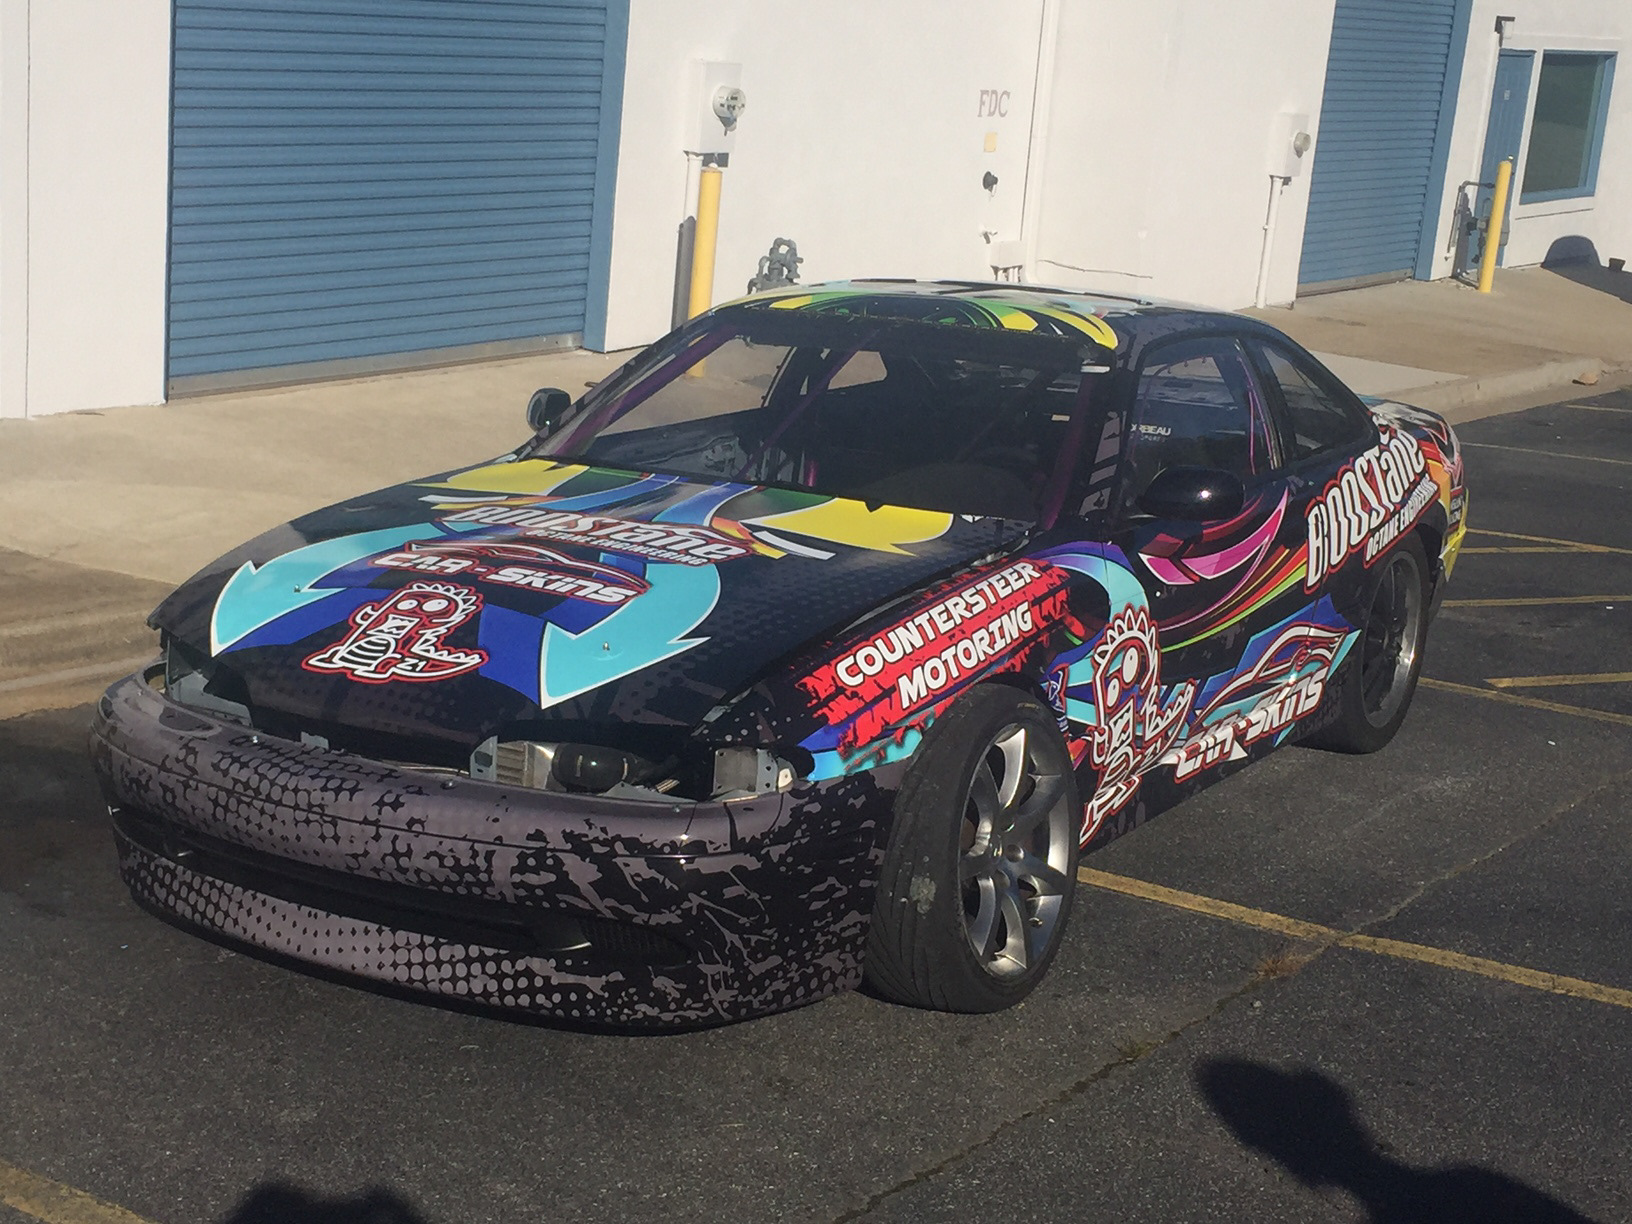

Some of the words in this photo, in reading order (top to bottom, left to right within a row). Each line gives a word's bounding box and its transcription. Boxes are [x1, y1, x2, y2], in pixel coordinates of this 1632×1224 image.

[977, 89, 1011, 118] FDC
[595, 537, 707, 565] ENGINEERING
[835, 561, 1042, 687] COUNTERSTEER
[897, 601, 1032, 709] MOTORING
